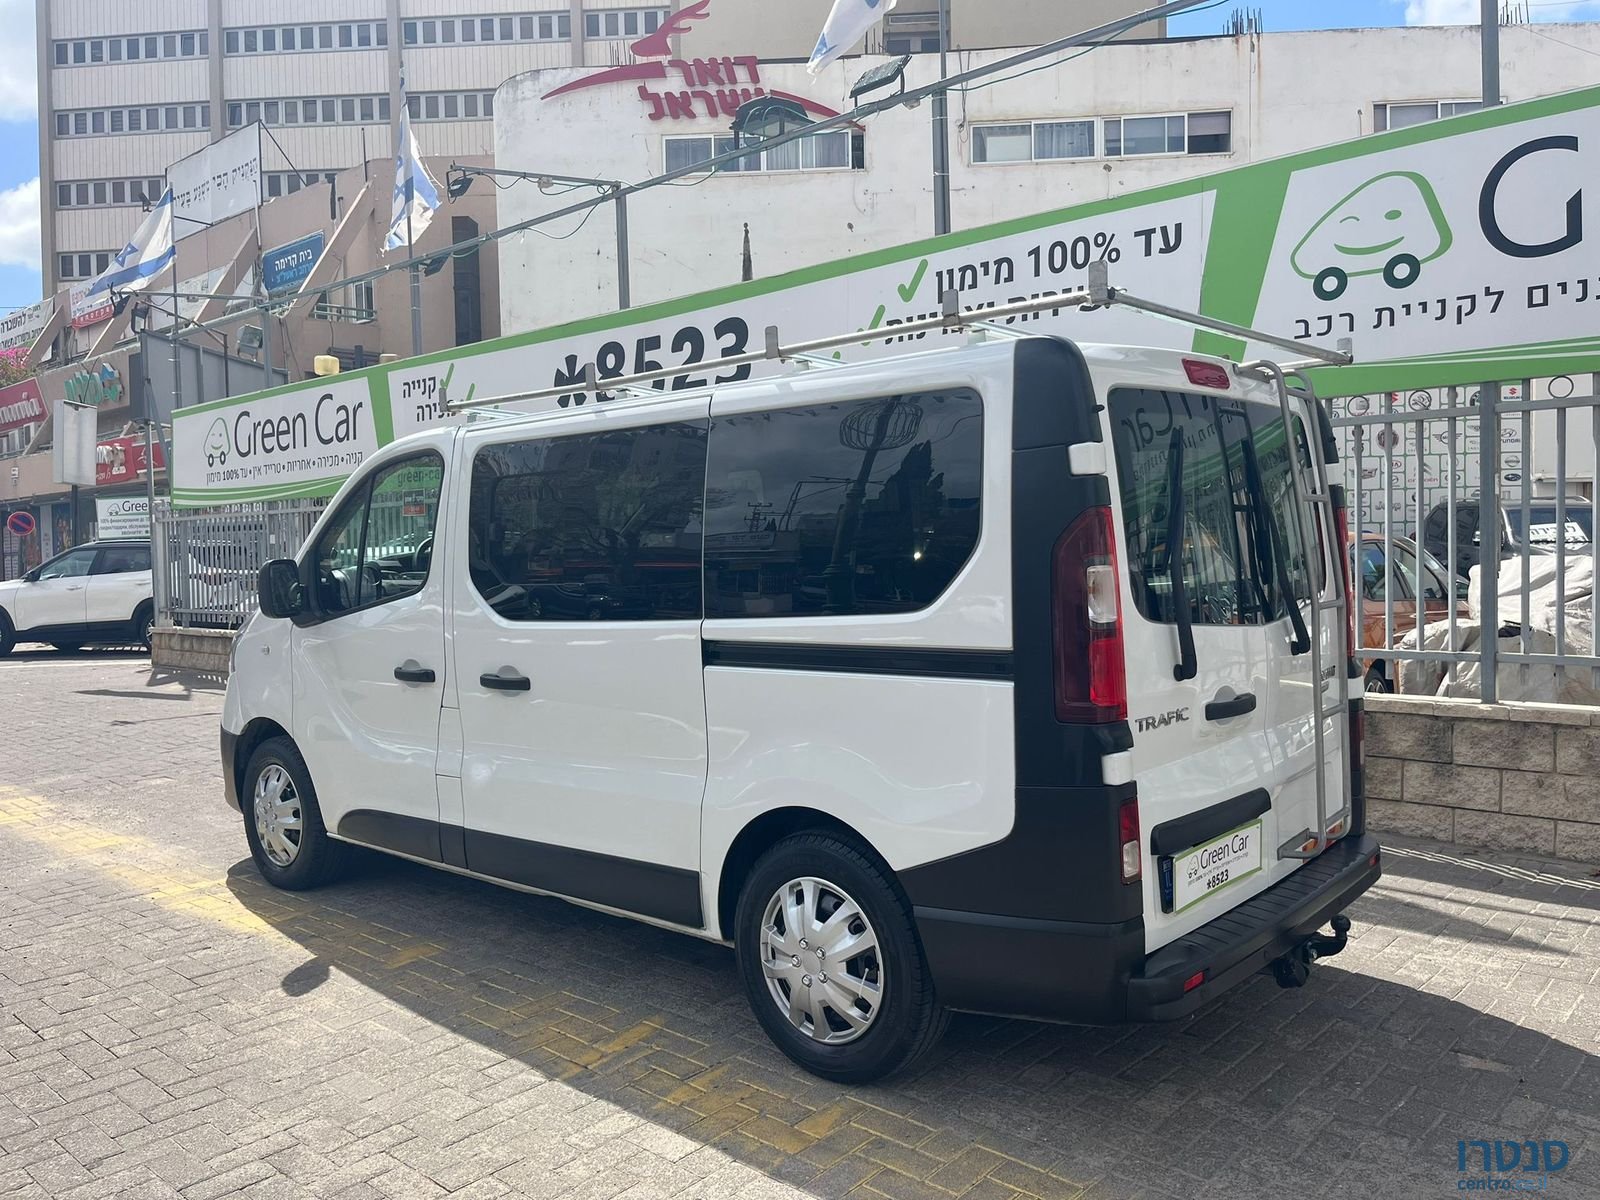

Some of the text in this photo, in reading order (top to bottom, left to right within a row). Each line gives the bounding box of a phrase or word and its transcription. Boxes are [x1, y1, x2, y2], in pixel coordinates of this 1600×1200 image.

[668, 56, 761, 87] דואר
[637, 84, 764, 121] ישראל
[935, 222, 1183, 304] עד 100% מימון
[1294, 275, 1600, 339] נים לקניית רכב
[403, 376, 437, 399] קנייה
[234, 393, 363, 458] Green Car
[222, 468, 240, 481] 100%
[317, 454, 340, 469] מכירה
[345, 451, 363, 467] קניה
[1134, 707, 1190, 733] TRAFIC
[1200, 843, 1230, 870] Green
[1231, 834, 1249, 854] Car
